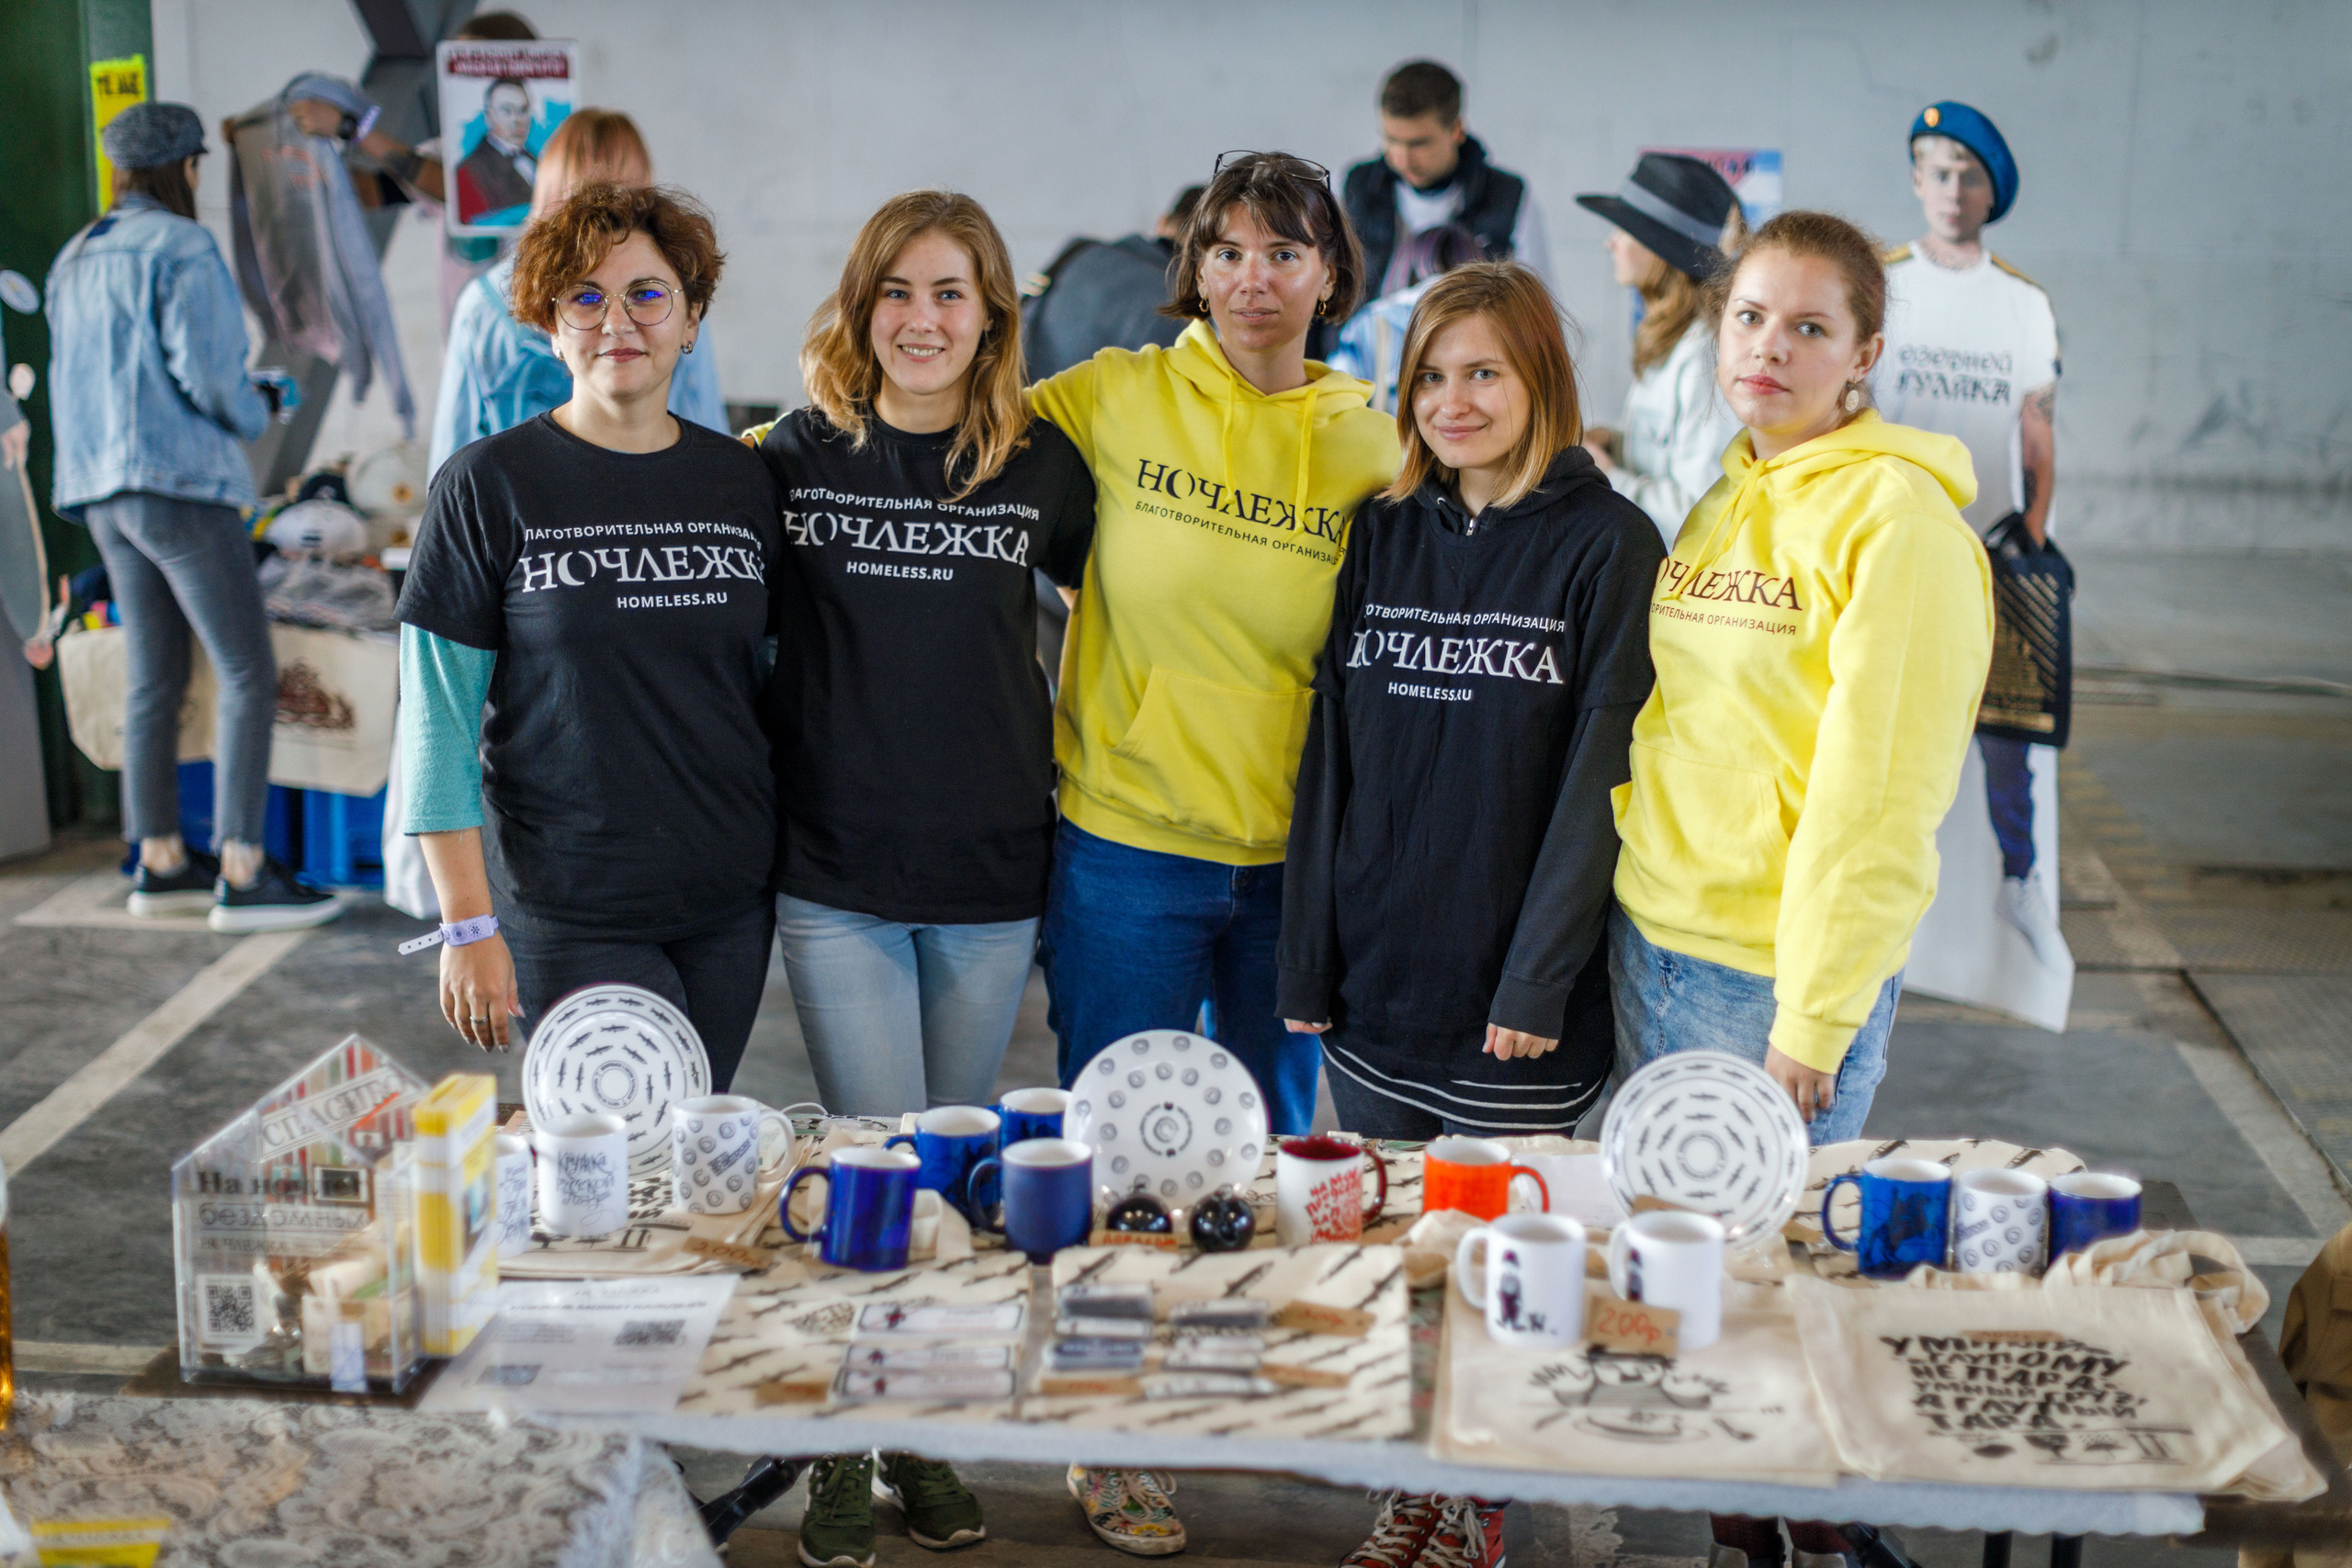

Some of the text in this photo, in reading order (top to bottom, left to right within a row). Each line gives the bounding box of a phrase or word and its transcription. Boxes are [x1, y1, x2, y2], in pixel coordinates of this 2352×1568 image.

[937, 503, 1039, 521] ОРГАНИЗАЦИЯ
[1135, 501, 1267, 546] БЛАГОТВОРИТЕЛЬНАЯ
[526, 523, 684, 542] ЛАГОТВОРИТЕЛЬНАЯ
[783, 511, 1027, 567] НОЧЛЕЖКА
[846, 561, 955, 581] HOMELESS.RU
[617, 592, 728, 608] HOMELESS.RU
[1364, 604, 1565, 632] ОТВОРИТЕЛЬНАЯ ОРГАНИЗАЦИЯ
[1651, 603, 1796, 636] ОРИТЕЛЬНАЯ ОРГАНИЗАЦИЯ
